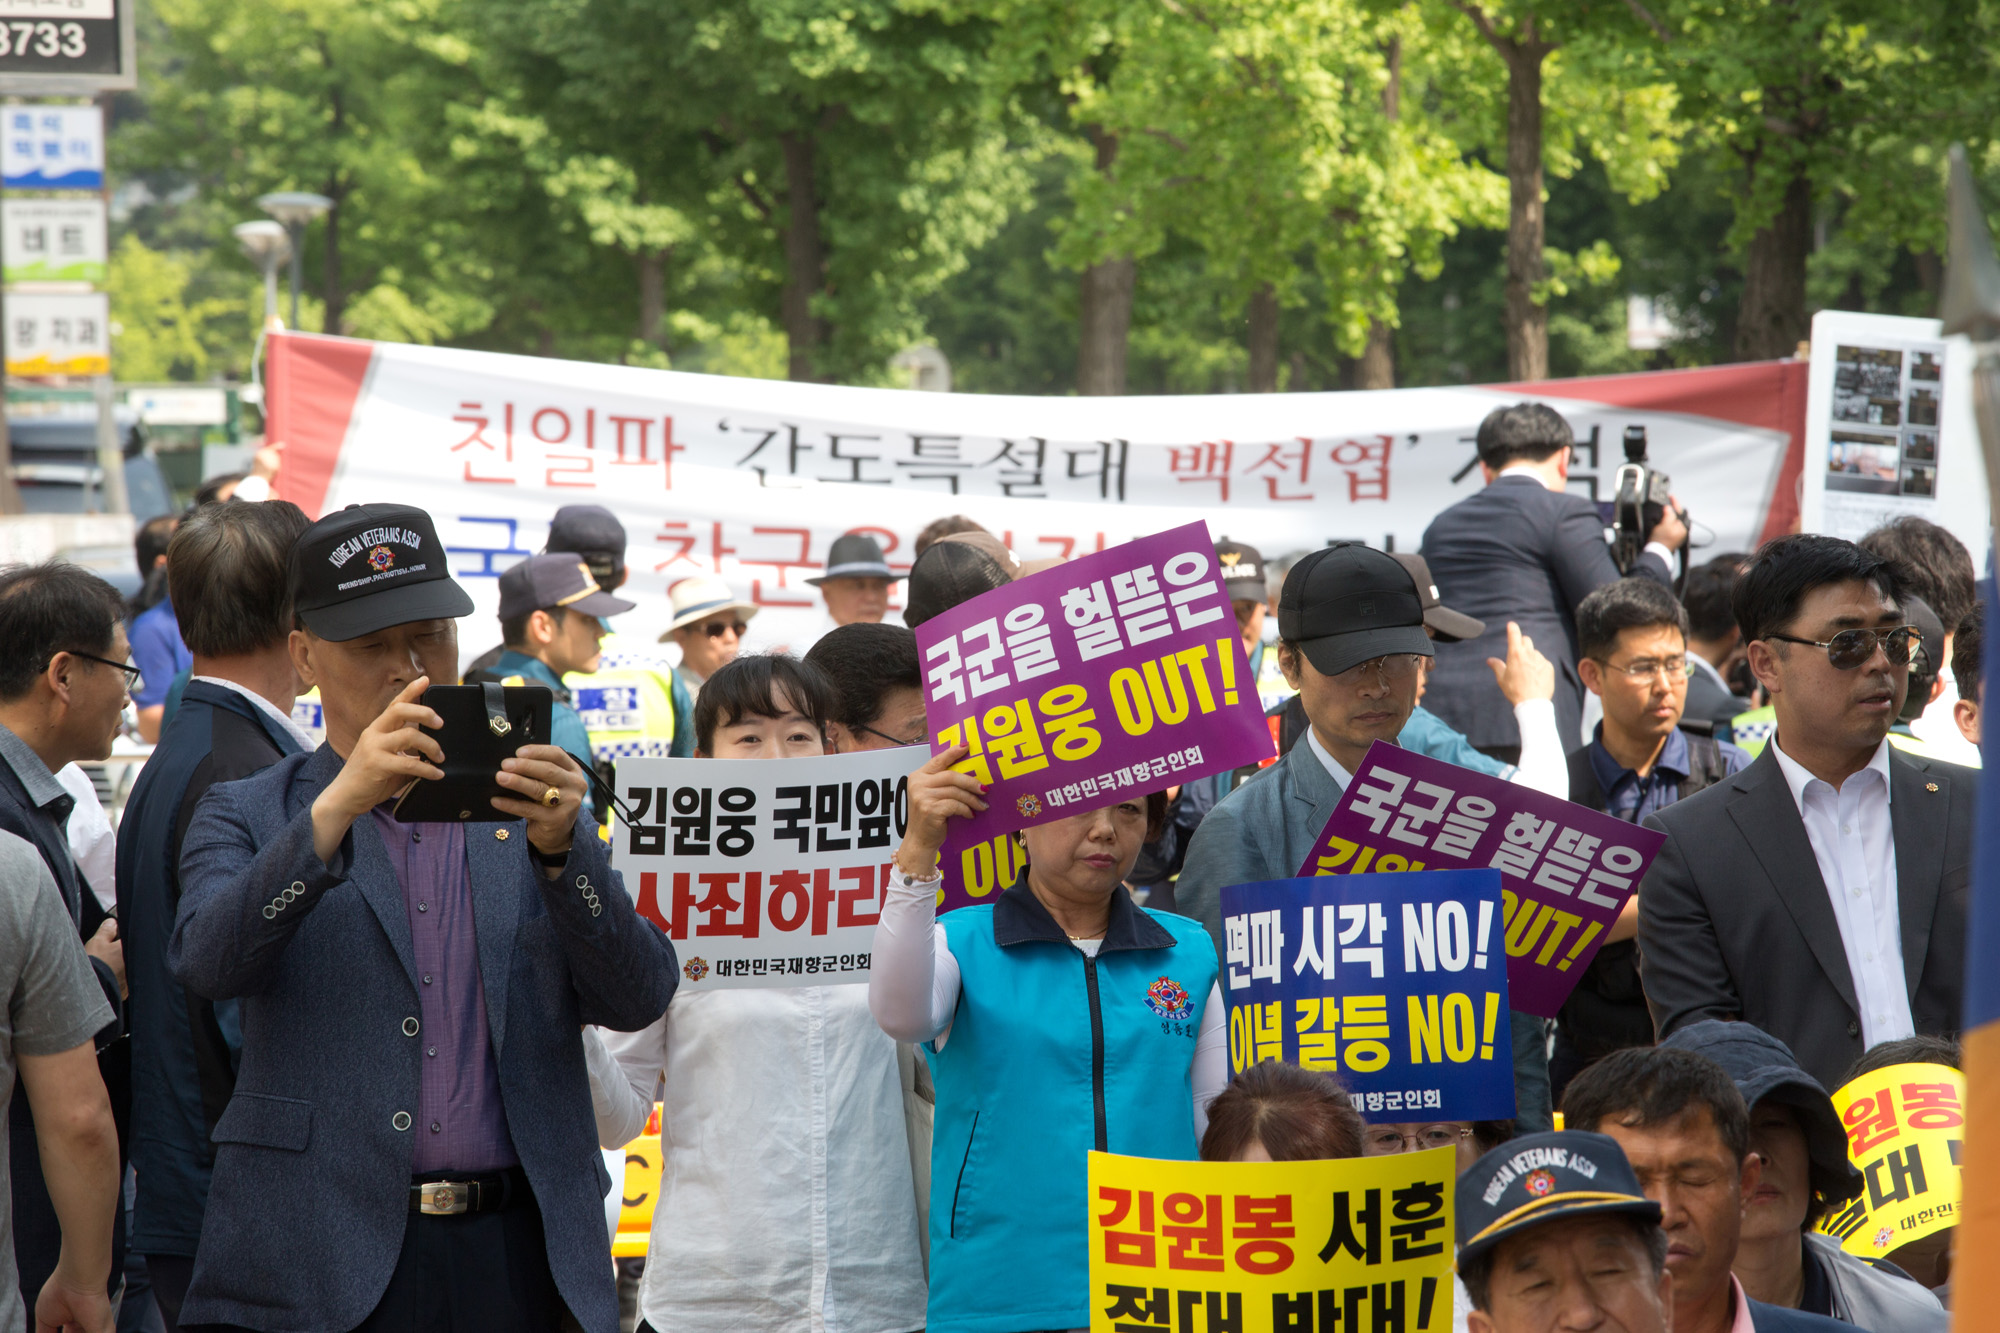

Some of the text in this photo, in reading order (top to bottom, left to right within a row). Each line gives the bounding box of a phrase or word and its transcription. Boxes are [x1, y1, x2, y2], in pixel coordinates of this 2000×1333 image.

[450, 402, 685, 490] 친일파
[328, 537, 364, 568] KOREAN
[359, 527, 401, 548] VETERANS
[926, 552, 1225, 706] 국군을 헐뜯은
[937, 638, 1239, 787] 김원웅 OUT!
[1045, 745, 1205, 808] 대한민국재향군인회
[627, 787, 757, 857] 김원웅
[1349, 765, 1497, 860] 국군을
[1488, 811, 1644, 910] 헐뜯은
[716, 953, 872, 977] 대한민국재향군인회
[1225, 900, 1494, 990] 편파 시각 NO!
[1230, 992, 1501, 1074] 이념 갈등 NO!
[1843, 1083, 1964, 1159] 원봉
[1482, 1164, 1516, 1206] KOREAN
[1508, 1147, 1569, 1176] VETERANS
[1098, 1181, 1446, 1275] 김원봉 서훈
